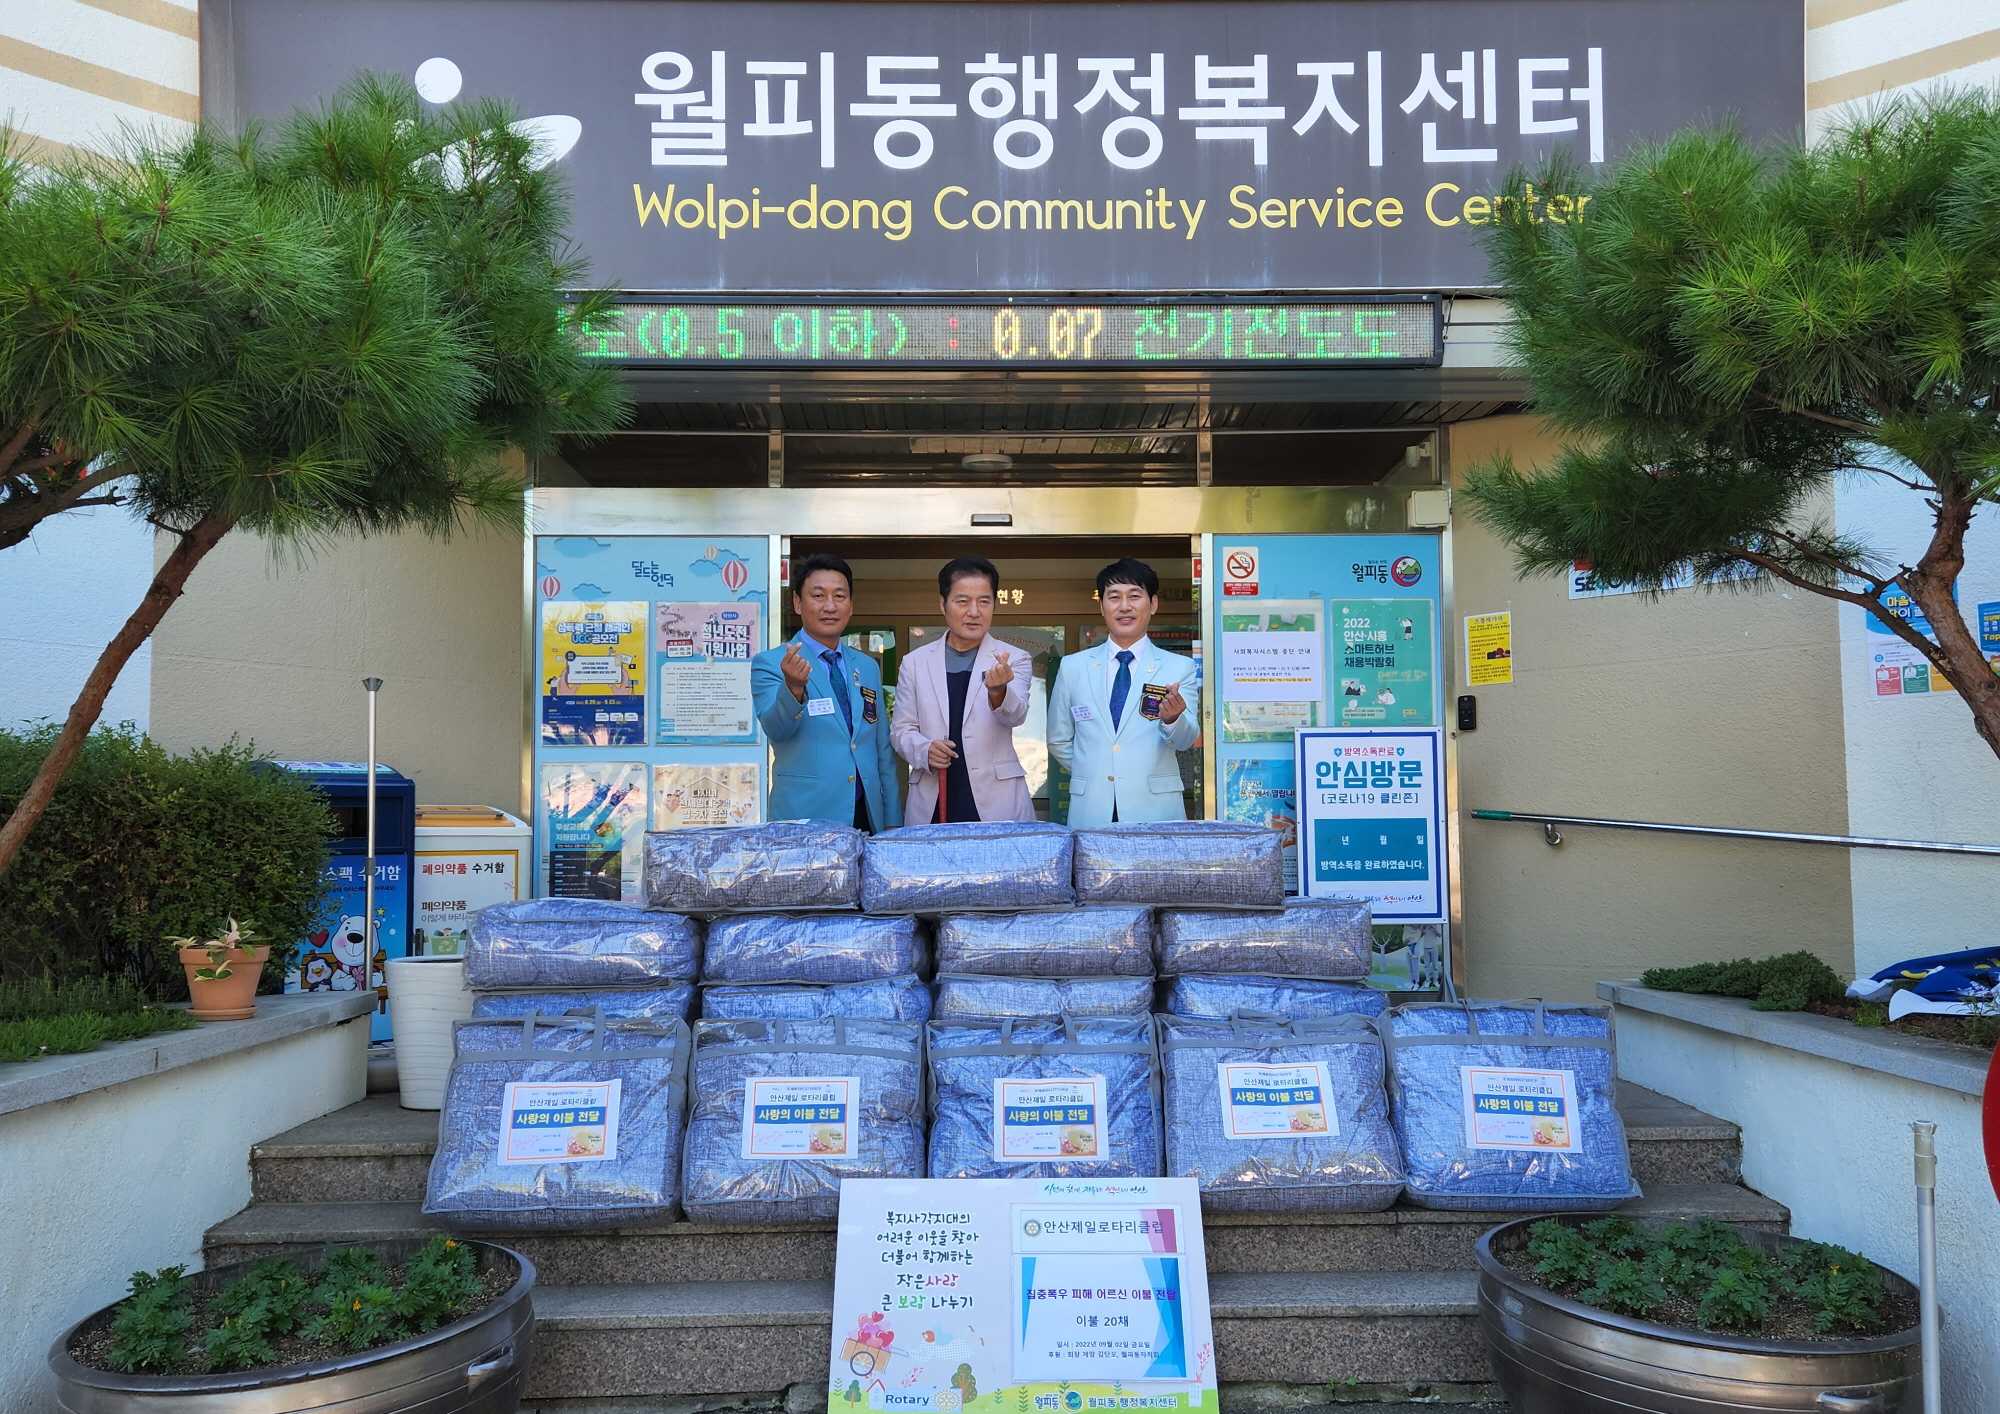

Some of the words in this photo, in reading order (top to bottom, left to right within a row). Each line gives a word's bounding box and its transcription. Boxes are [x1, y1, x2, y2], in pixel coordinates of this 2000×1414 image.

[634, 48, 1605, 170] 월피동행정복지센터
[633, 183, 912, 241] Wolpi-dong
[933, 184, 1207, 240] Community
[1229, 183, 1404, 229] Service
[1425, 182, 1593, 227] Center
[773, 308, 908, 359] 이하)
[993, 307, 1103, 360] 0.07
[1133, 307, 1401, 360] 전기전도도
[1352, 563, 1388, 584] 월피동
[1343, 618, 1370, 629] 2022
[701, 622, 749, 640] 청년도전
[1343, 630, 1387, 642] 안산·시흥
[572, 634, 591, 644] UCC
[591, 634, 619, 645] 공모전
[701, 641, 749, 659] 지원사업
[1233, 648, 1279, 656] 사회복지시스템
[1344, 643, 1395, 655] 스마트허브
[1344, 656, 1395, 668] 채용박람회
[1344, 747, 1395, 757] 방역소독완료
[1315, 760, 1423, 789] 안심방문
[691, 788, 718, 798] 다자녀
[1271, 789, 1296, 799] 열립니
[1321, 793, 1376, 805] [코로나19
[1379, 793, 1419, 805] 클린존]
[682, 809, 708, 819] 입주자
[1341, 835, 1350, 846] 년
[1379, 835, 1388, 846] 월
[1416, 834, 1425, 846] 일
[422, 863, 468, 876] 폐의약품
[471, 862, 505, 875] 수거함
[1320, 860, 1362, 871] 방역소독을
[1364, 859, 1426, 871] 완료하였습니다.
[421, 900, 468, 912] 폐의약품
[421, 913, 446, 923] 이렇게
[448, 912, 467, 922] 버리
[1243, 1078, 1271, 1086] 안산제일
[1273, 1078, 1308, 1087] 로타리클럽
[1487, 1084, 1516, 1093] 안산제일
[1518, 1086, 1553, 1095] 로타리클럽
[529, 1099, 559, 1107] 안산제일
[560, 1097, 597, 1106] 로타리클럽
[769, 1094, 798, 1102] 안산제일
[800, 1093, 836, 1102] 로타리클럽
[1018, 1095, 1047, 1104] 안산제일
[1048, 1094, 1084, 1103] 로타리클럽
[1235, 1091, 1266, 1103] 사랑의
[1269, 1091, 1291, 1103] 이불
[1293, 1090, 1315, 1102] 전달
[1478, 1098, 1510, 1110] 사랑의
[1513, 1099, 1535, 1112] 이불
[1537, 1101, 1559, 1113] 전달
[516, 1112, 550, 1125] 사랑의
[553, 1112, 575, 1124] 이불
[577, 1110, 600, 1122] 전달
[759, 1109, 791, 1121] 사랑의
[794, 1108, 815, 1120] 이불
[818, 1107, 840, 1120] 전달
[1008, 1110, 1040, 1122] 사랑의
[1043, 1110, 1064, 1122] 이불
[1067, 1109, 1089, 1121] 전달
[885, 1210, 971, 1227] 복지사각지대의
[1043, 1220, 1164, 1234] 안산제일로타리클럽
[876, 1230, 914, 1245] 어려운
[917, 1230, 948, 1245] 이웃을
[951, 1229, 980, 1245] 찾아
[881, 1249, 918, 1266] 더불어
[922, 1248, 975, 1265] 함께하는
[1026, 1288, 1069, 1301] 집중폭우
[1071, 1288, 1094, 1300] 피해
[1096, 1288, 1128, 1300] 어르신
[1131, 1288, 1153, 1301] 이불
[1155, 1288, 1177, 1301] 전달
[881, 1294, 893, 1312] 큰
[897, 1295, 927, 1310] 보람
[930, 1295, 974, 1310] 나누기
[1076, 1315, 1100, 1328] 이불
[1103, 1315, 1130, 1328] 20채
[1056, 1340, 1070, 1349] 일시
[1075, 1340, 1097, 1349] 2022년
[1098, 1340, 1113, 1349] 09월
[1114, 1340, 1129, 1349] 02일
[1130, 1340, 1151, 1349] 금요일
[1048, 1351, 1062, 1359] 후원
[1067, 1351, 1081, 1359] 회장
[885, 1394, 930, 1407] Rotary
[1034, 1395, 1060, 1411] 월피동
[1088, 1397, 1117, 1409] 월피동
[1119, 1397, 1178, 1409] 행정복지센터
